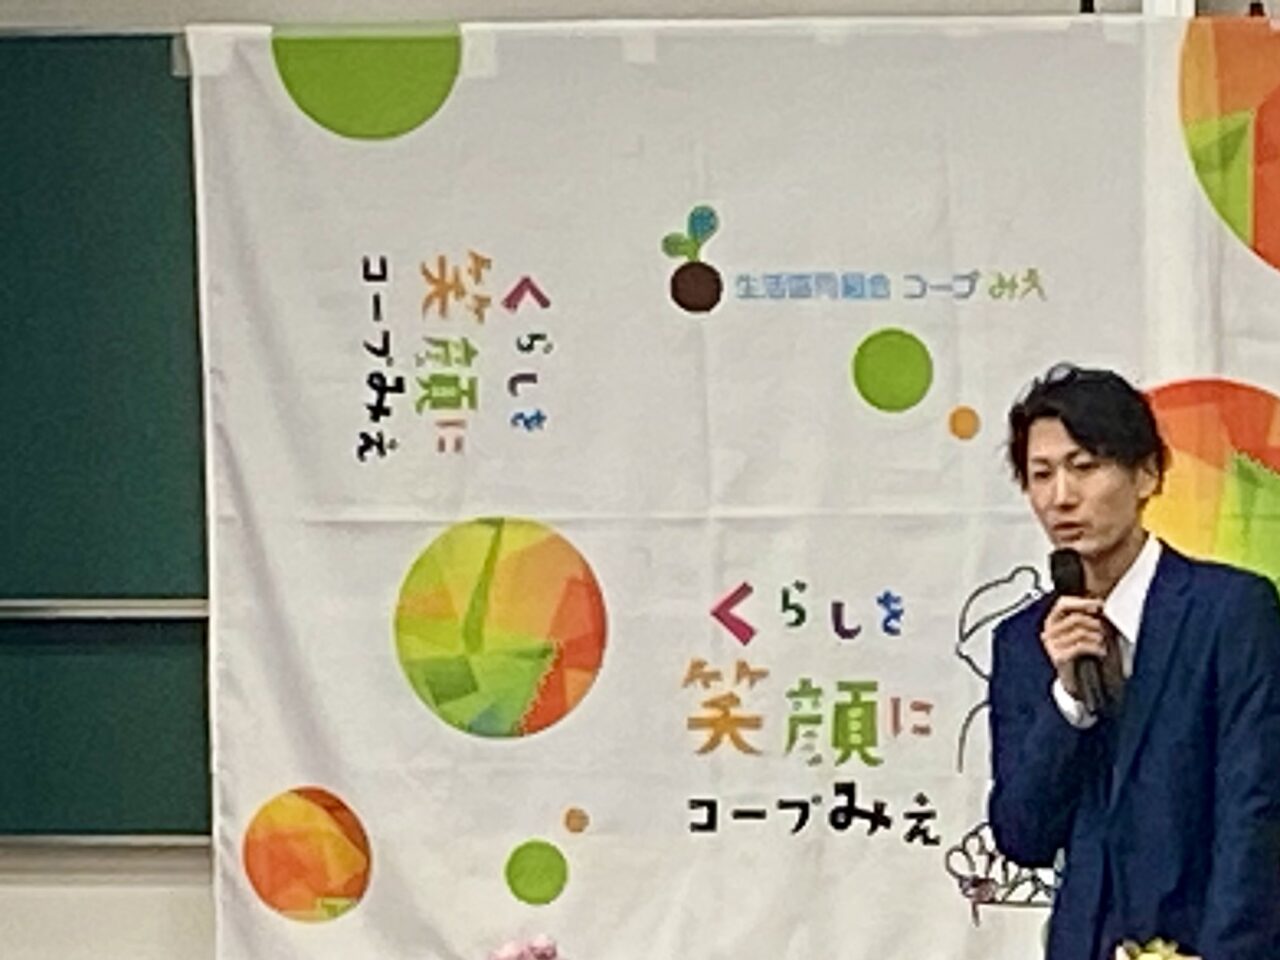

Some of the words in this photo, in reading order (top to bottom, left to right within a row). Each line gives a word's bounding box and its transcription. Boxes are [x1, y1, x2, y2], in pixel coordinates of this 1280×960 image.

[710, 580, 905, 647] くらしを
[681, 657, 934, 768] 笑顔に
[688, 781, 940, 847] コープみえ
